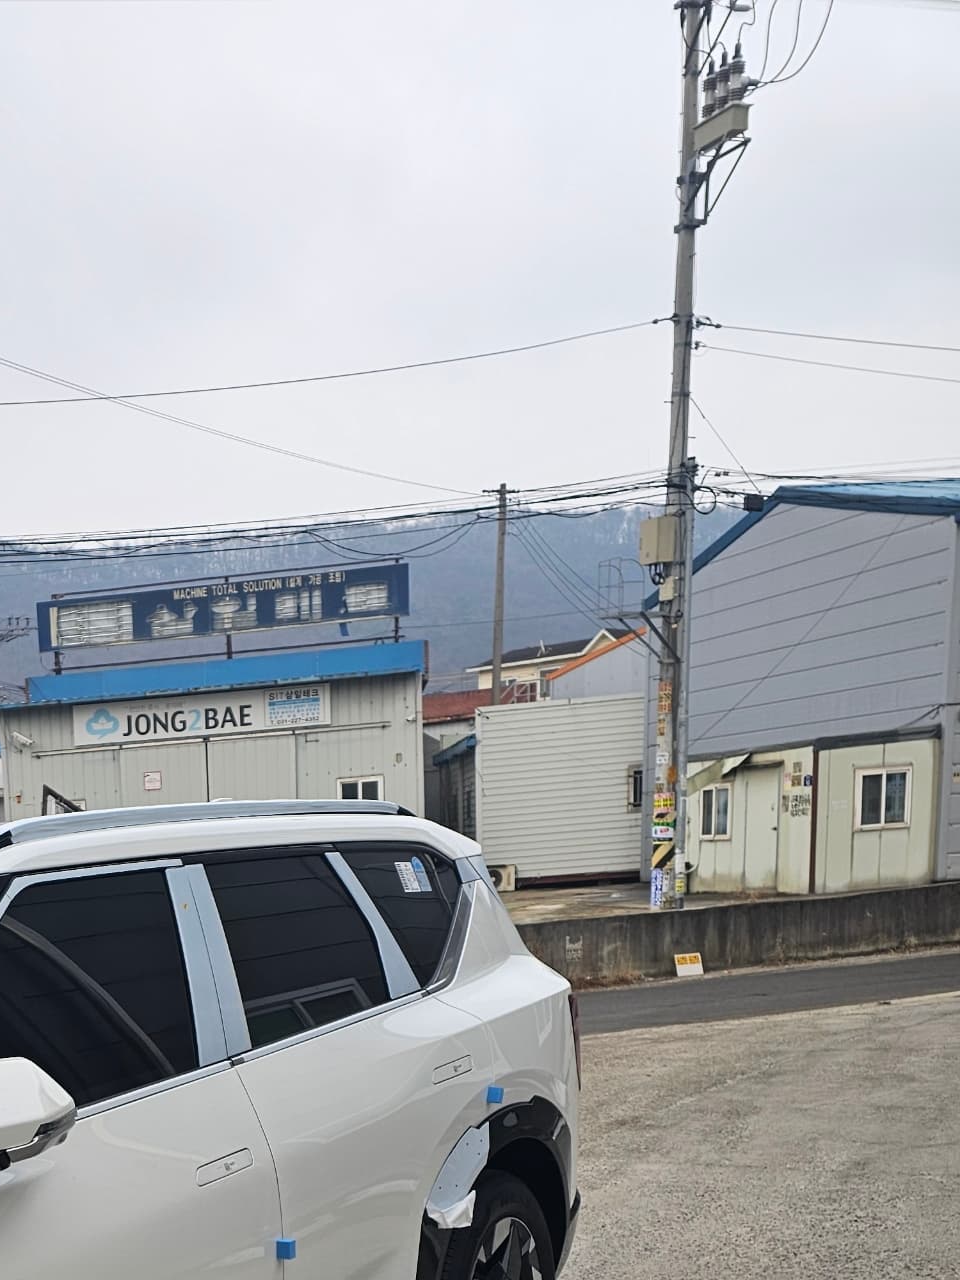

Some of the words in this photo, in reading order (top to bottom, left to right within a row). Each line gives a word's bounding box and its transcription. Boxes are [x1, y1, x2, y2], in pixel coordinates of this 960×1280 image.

[173, 588, 208, 600] MACHINE
[212, 583, 238, 595] TOTAL
[243, 578, 282, 593] SOLUTION
[123, 704, 253, 737] JONG2BAE
